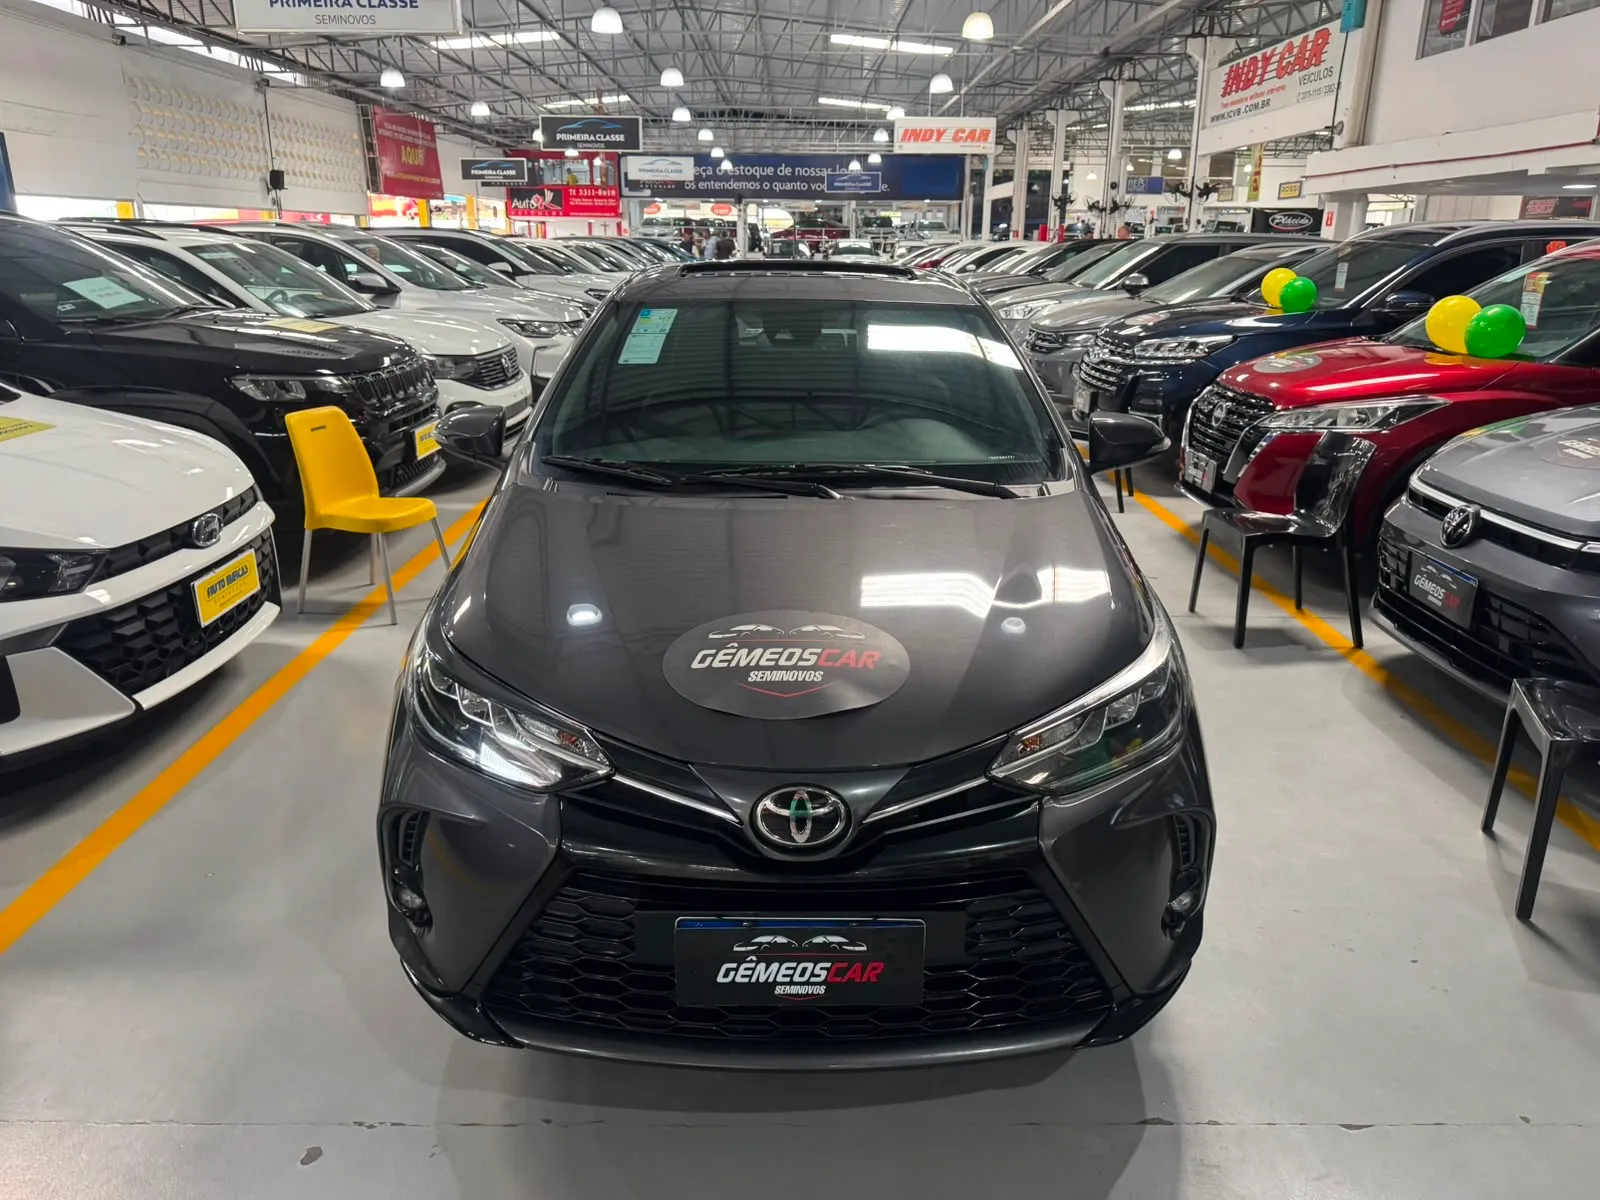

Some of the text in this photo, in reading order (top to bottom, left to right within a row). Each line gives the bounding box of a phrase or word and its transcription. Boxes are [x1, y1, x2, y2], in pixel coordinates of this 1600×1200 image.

[315, 14, 376, 25] SEMINOVOS
[1221, 47, 1277, 98] INDY
[1276, 27, 1329, 80] CAR
[1298, 66, 1334, 86] VEÍCULOS
[556, 133, 625, 142] PRIMEIRA CLASSE
[900, 128, 992, 143] INDY CAR
[727, 165, 774, 179] estoque
[777, 163, 791, 176] de
[698, 178, 761, 190] entendemos
[763, 182, 771, 190] o
[772, 180, 808, 192] quanto
[690, 643, 882, 670] GÊMEOSCAR
[747, 670, 824, 682] SEMINOVOS
[716, 955, 885, 983] GÊMEOSCAR
[774, 985, 827, 995] SEMINOVOS
